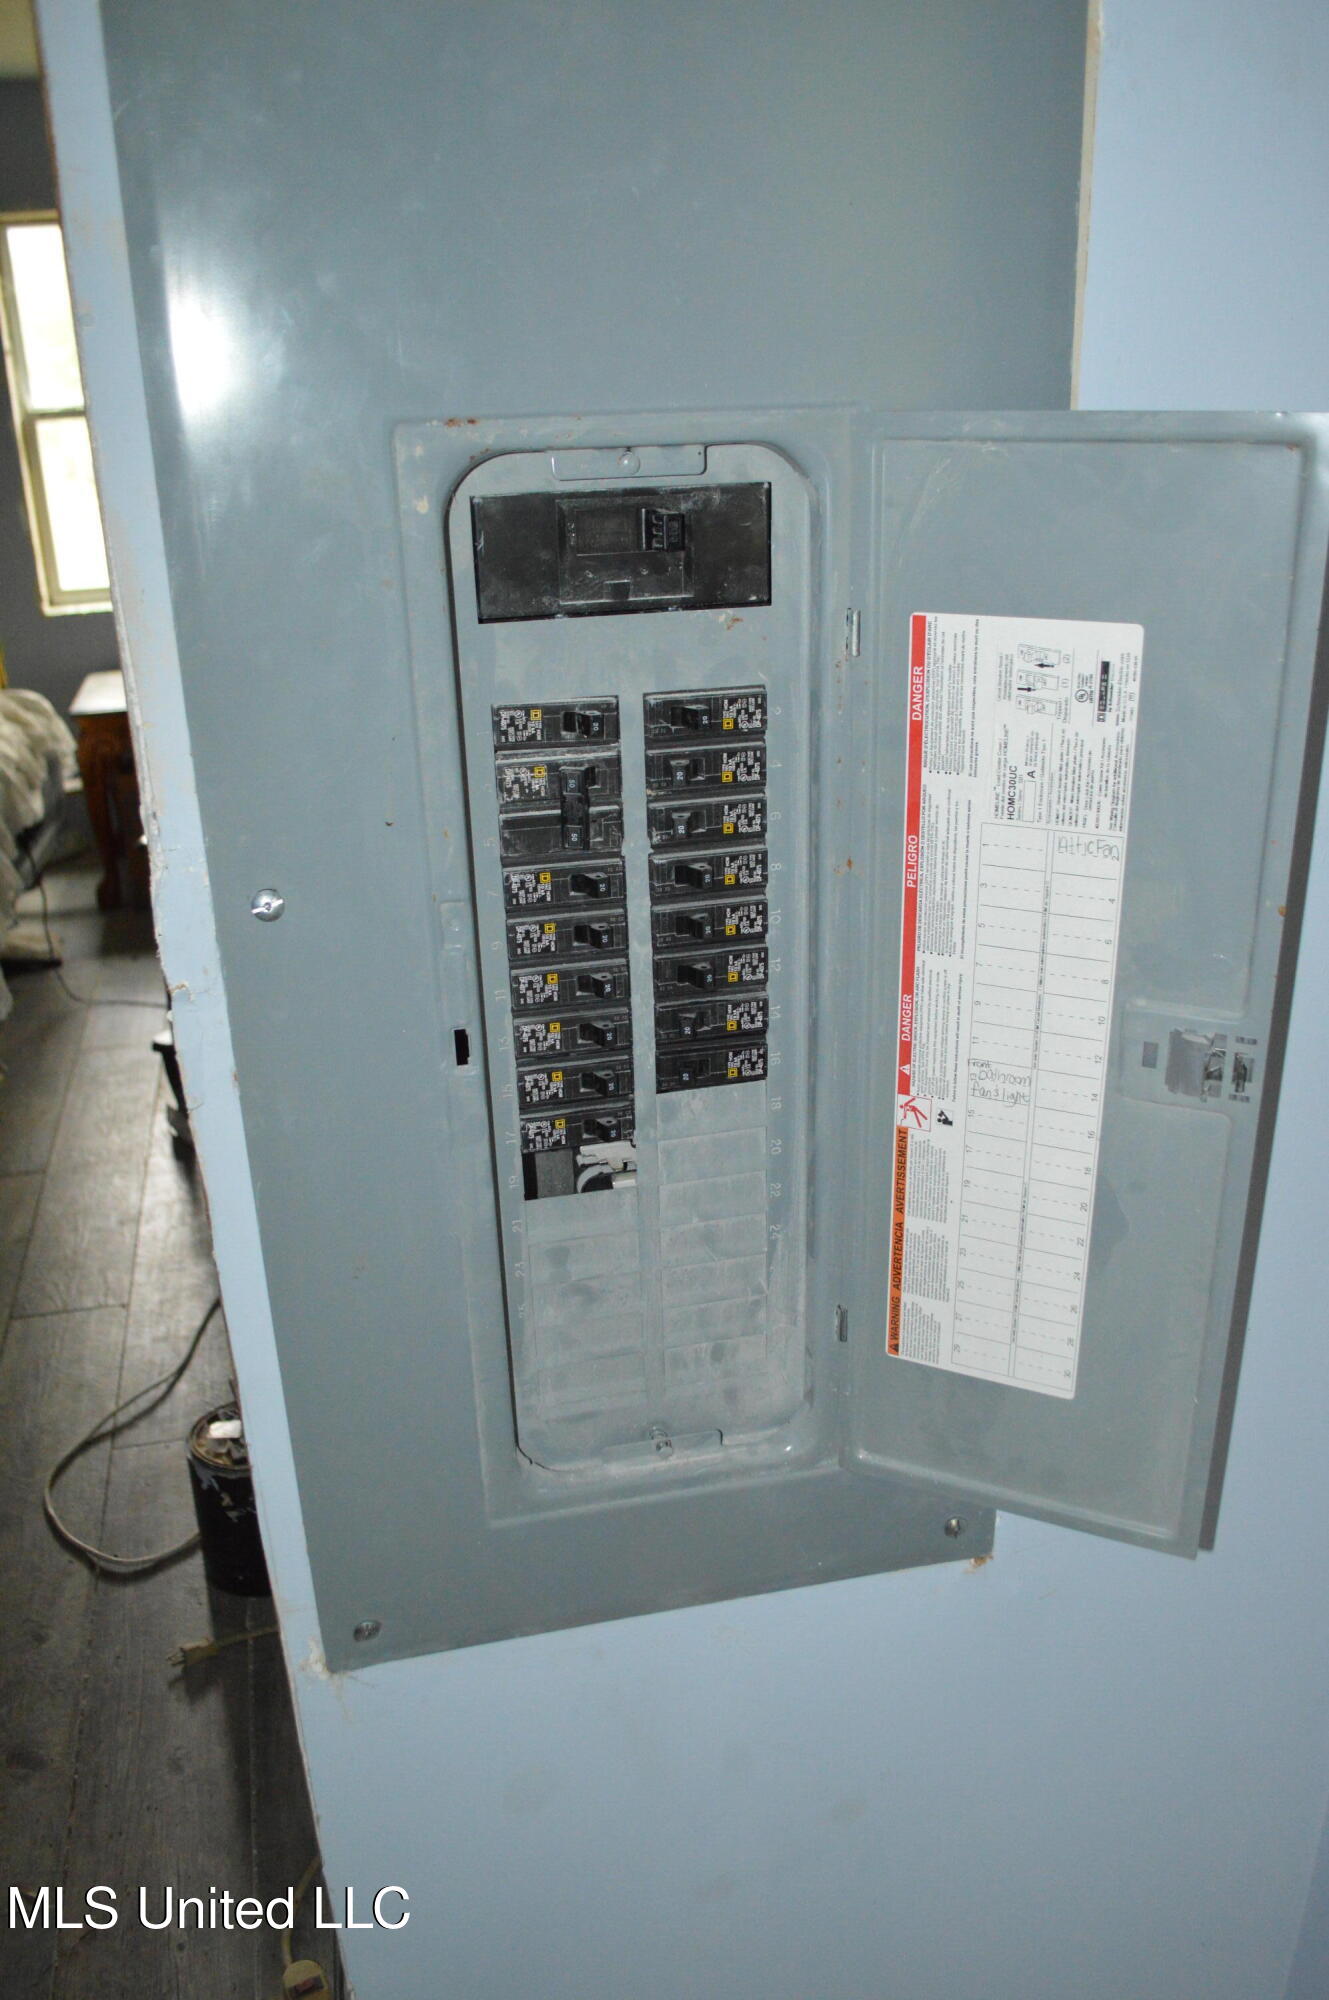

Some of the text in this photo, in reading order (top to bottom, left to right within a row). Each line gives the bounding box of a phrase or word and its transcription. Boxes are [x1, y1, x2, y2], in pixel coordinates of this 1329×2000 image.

[912, 666, 923, 721] DANGER
[676, 771, 684, 780] 20
[1027, 770, 1036, 779] A
[1007, 765, 1017, 820] HOMC30UC
[770, 811, 782, 821] 6
[678, 825, 685, 834] 20
[571, 833, 578, 842] 50
[770, 862, 782, 872] 8
[906, 835, 918, 888] PELIGRO
[600, 883, 606, 892] 20
[770, 909, 782, 925] 10
[769, 957, 781, 972] 12
[901, 994, 913, 1042] DANGER
[770, 1051, 781, 1066] 16
[771, 1097, 782, 1110] 18
[770, 1138, 782, 1155] 20
[770, 1183, 782, 1197] 22
[512, 1219, 522, 1233] 21
[891, 1128, 907, 1341] WARNING ADVERTENCIA AVERTISSEMENT
